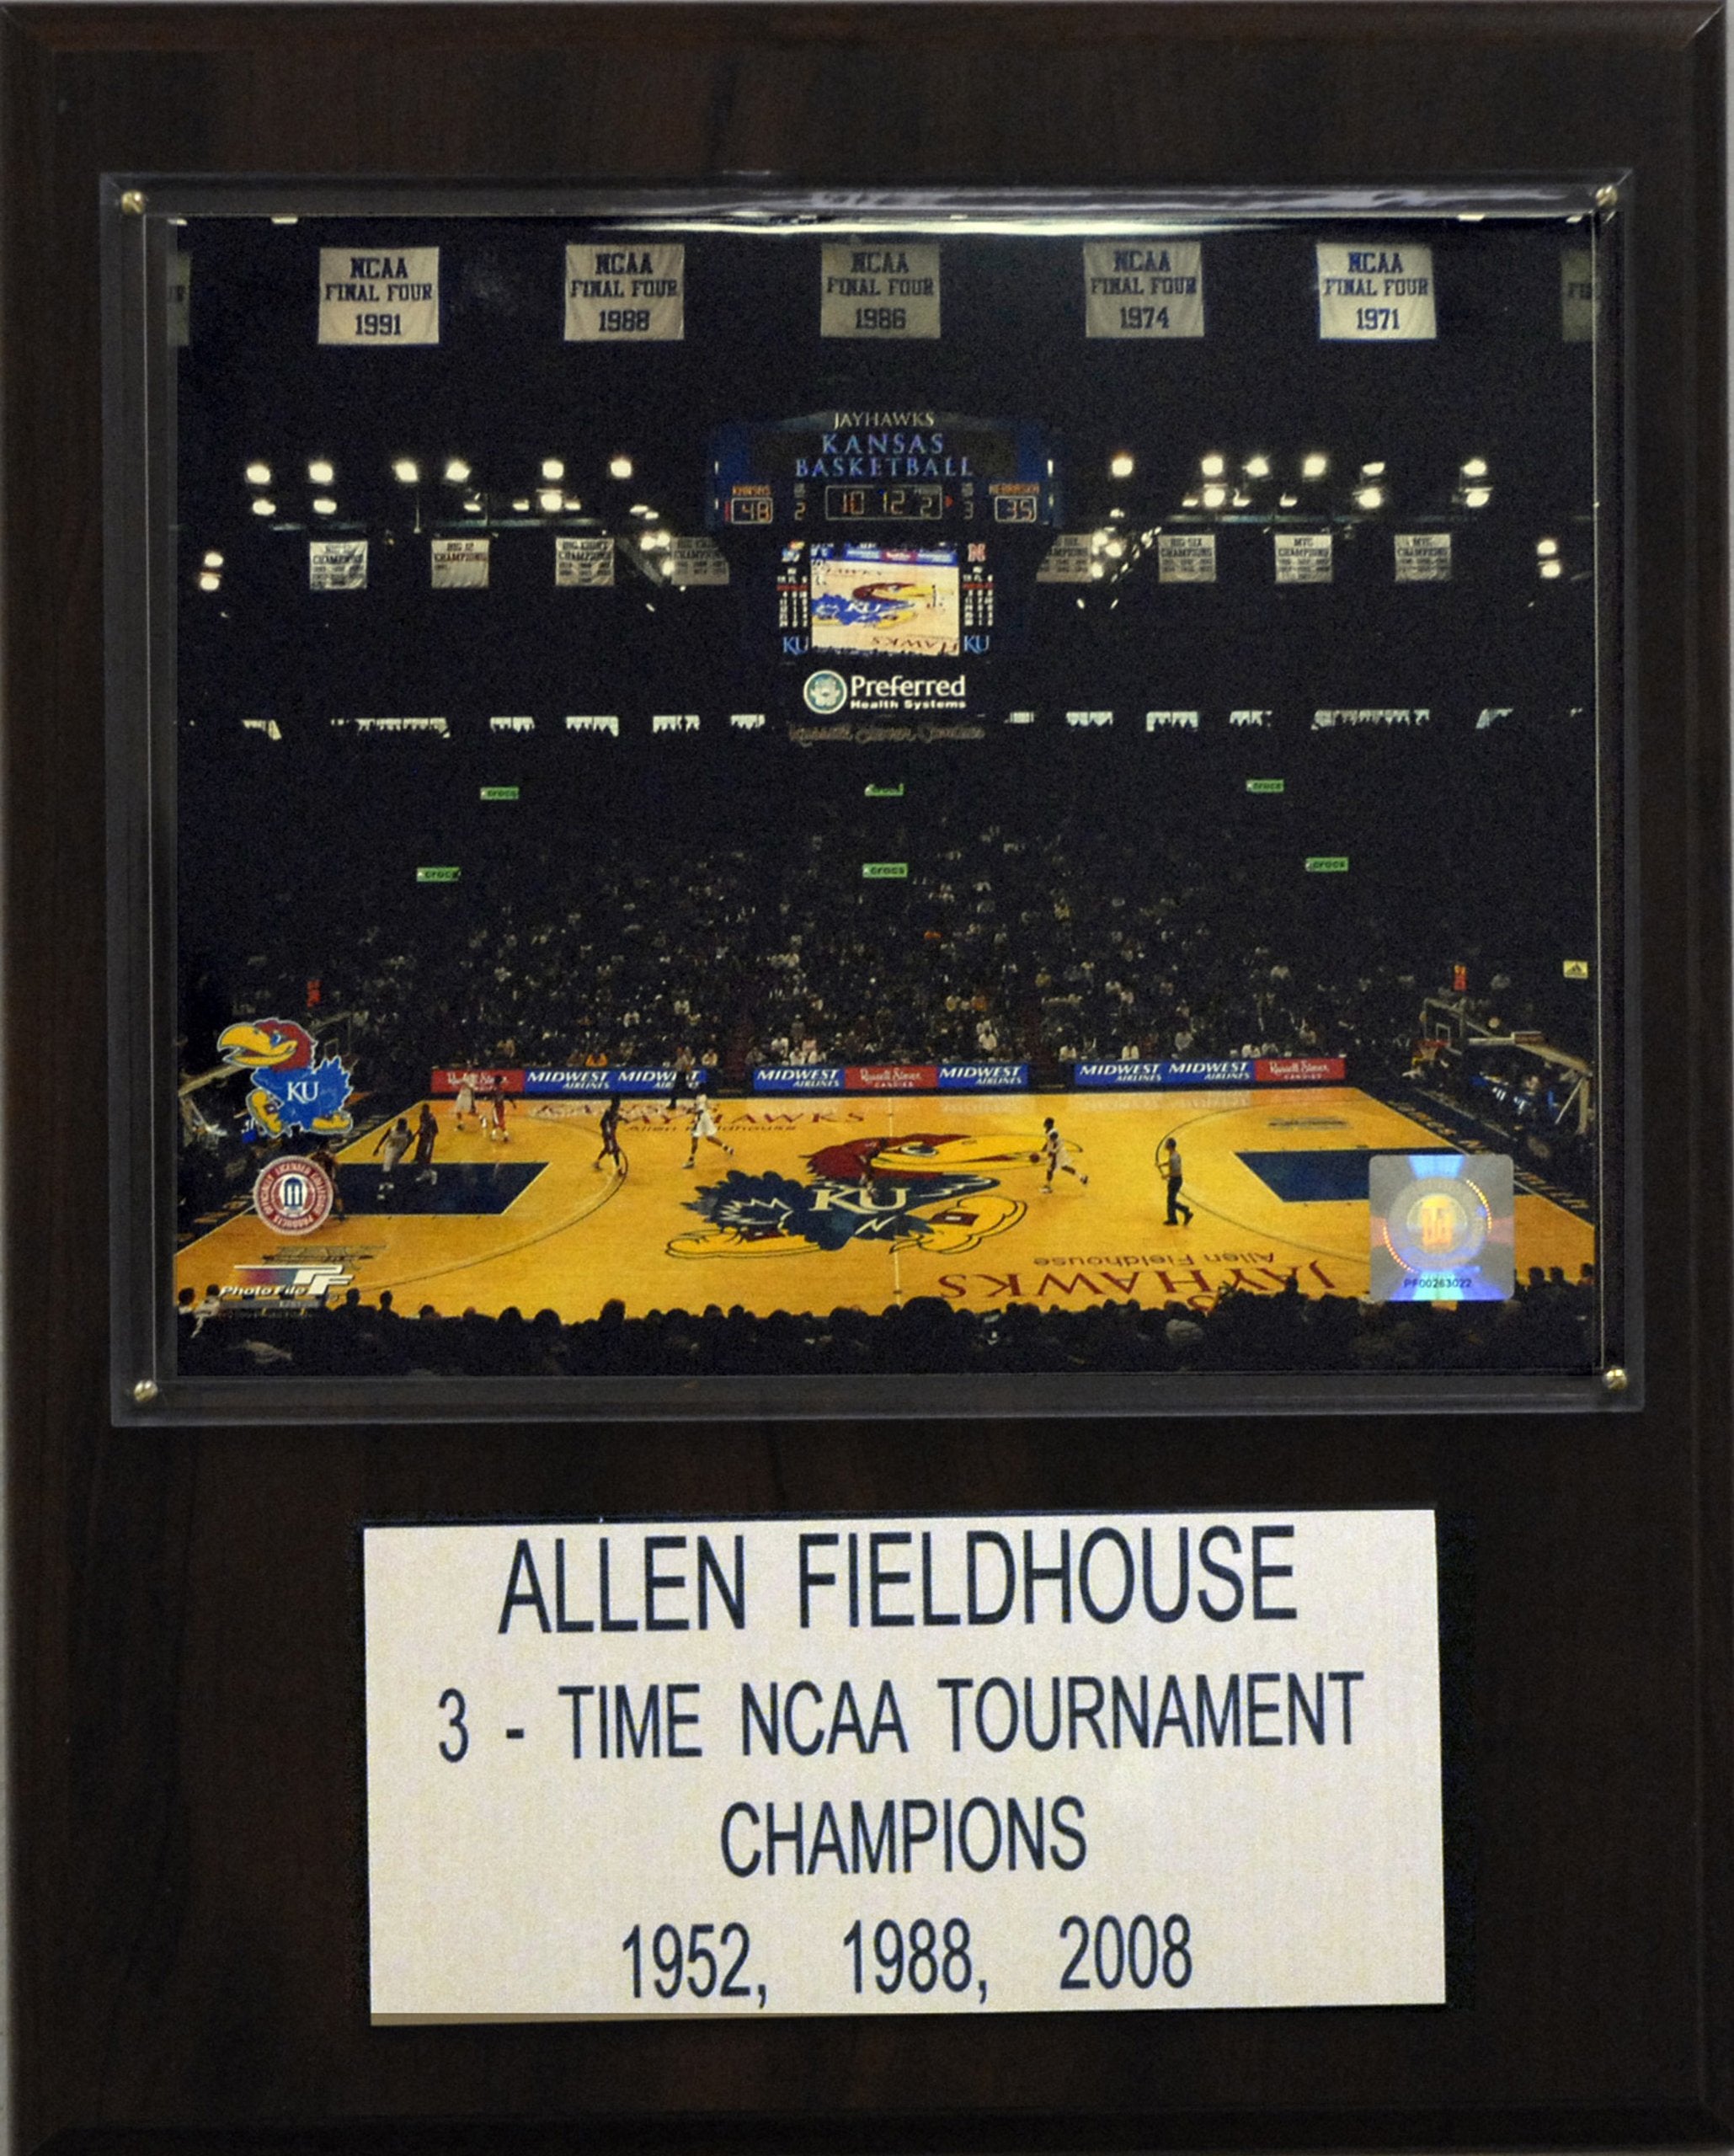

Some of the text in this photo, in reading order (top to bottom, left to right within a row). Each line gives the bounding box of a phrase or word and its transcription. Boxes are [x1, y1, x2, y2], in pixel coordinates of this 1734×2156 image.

[350, 258, 408, 279] NCAA
[596, 253, 654, 275] NCAA
[851, 253, 910, 274] NCAA
[1113, 250, 1171, 272] NCAA
[1348, 252, 1404, 274] NCAA
[325, 283, 433, 302] FINAL FOUR
[571, 279, 677, 298] FINAL FOUR
[827, 277, 934, 296] FINAL FOUR
[1091, 277, 1197, 295] FINAL FOUR
[1324, 279, 1429, 296] FINAL FOUR
[355, 313, 402, 336] 1991
[599, 310, 650, 332] 1988
[856, 307, 906, 330] 1986
[1120, 307, 1169, 329] 1974
[1357, 308, 1400, 330] 1971
[834, 412, 935, 429] JAYHAWKS
[822, 433, 943, 455] KANSAS
[795, 456, 974, 478] BASKETBALL
[783, 636, 808, 655] KU
[964, 635, 990, 654] KU
[851, 675, 966, 696] Preferred
[851, 700, 966, 710] Health Systems
[527, 1070, 609, 1082] MIDWEST
[618, 1070, 700, 1082] MIDWT
[757, 1069, 840, 1081] MIDWEST
[939, 1066, 1020, 1079] MIDWEST
[1079, 1063, 1162, 1075] MIDWEST
[1168, 1061, 1248, 1074] MIDWEST
[1204, 1072, 1250, 1081] AIRLINES
[792, 1080, 840, 1088] AIRLINES
[976, 1076, 1022, 1085] AIRLINES
[1114, 1074, 1162, 1082] AIRLINES
[287, 1081, 319, 1103] KU
[809, 1187, 911, 1214] KU
[1033, 1251, 1274, 1267] Allen Fieldhouse
[937, 1261, 1337, 1299] JAYHAWKS
[219, 1285, 308, 1297] Photo File
[499, 1524, 1298, 1635] ALLEN FIELDHOUSE
[439, 1688, 469, 1764] 3
[558, 1683, 702, 1759] TIME
[741, 1679, 909, 1757] NCAA
[937, 1671, 1364, 1753] TOURNAMENT
[721, 1796, 1086, 1878] CHAMPIONS
[622, 1913, 1192, 2009] 1952, 1988, 2008
